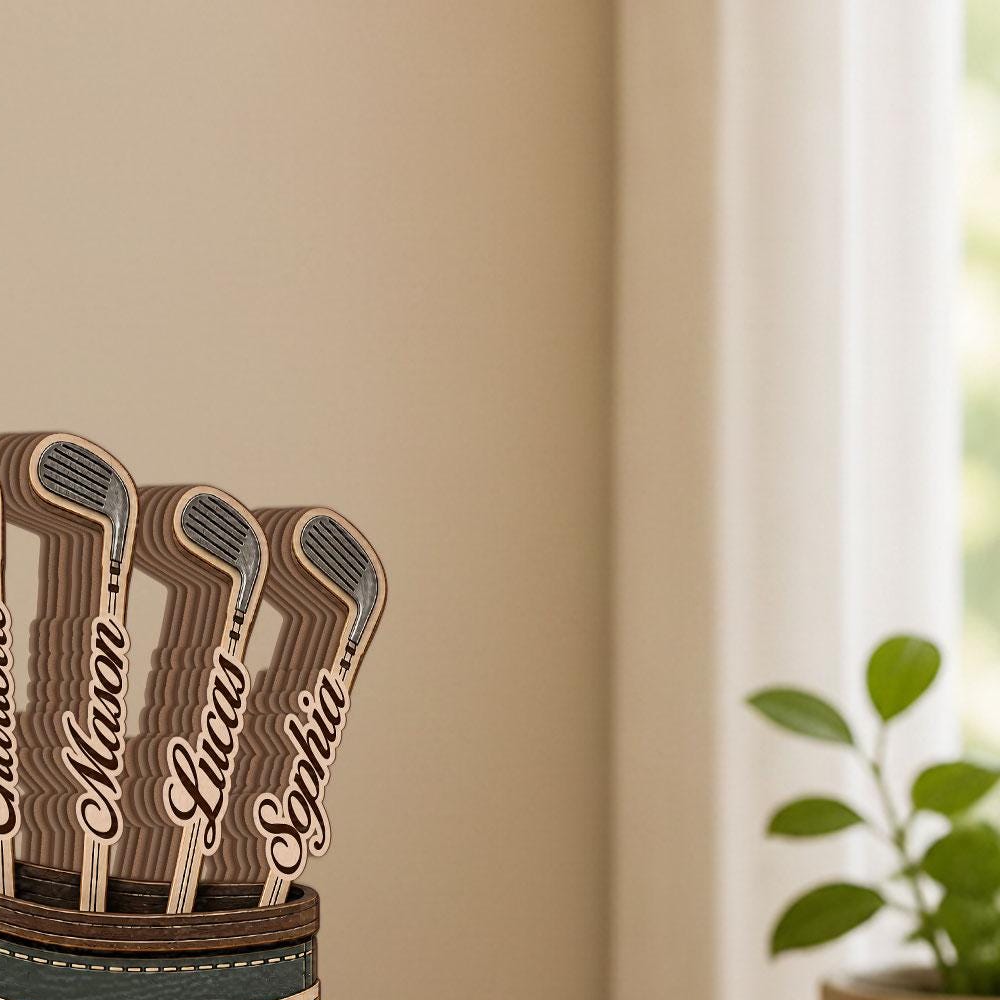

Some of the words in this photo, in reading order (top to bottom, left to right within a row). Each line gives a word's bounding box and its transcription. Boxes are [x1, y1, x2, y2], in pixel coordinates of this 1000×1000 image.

[66, 618, 125, 840] Mason
[168, 652, 246, 850] Lucas
[258, 674, 346, 875] Sophia
